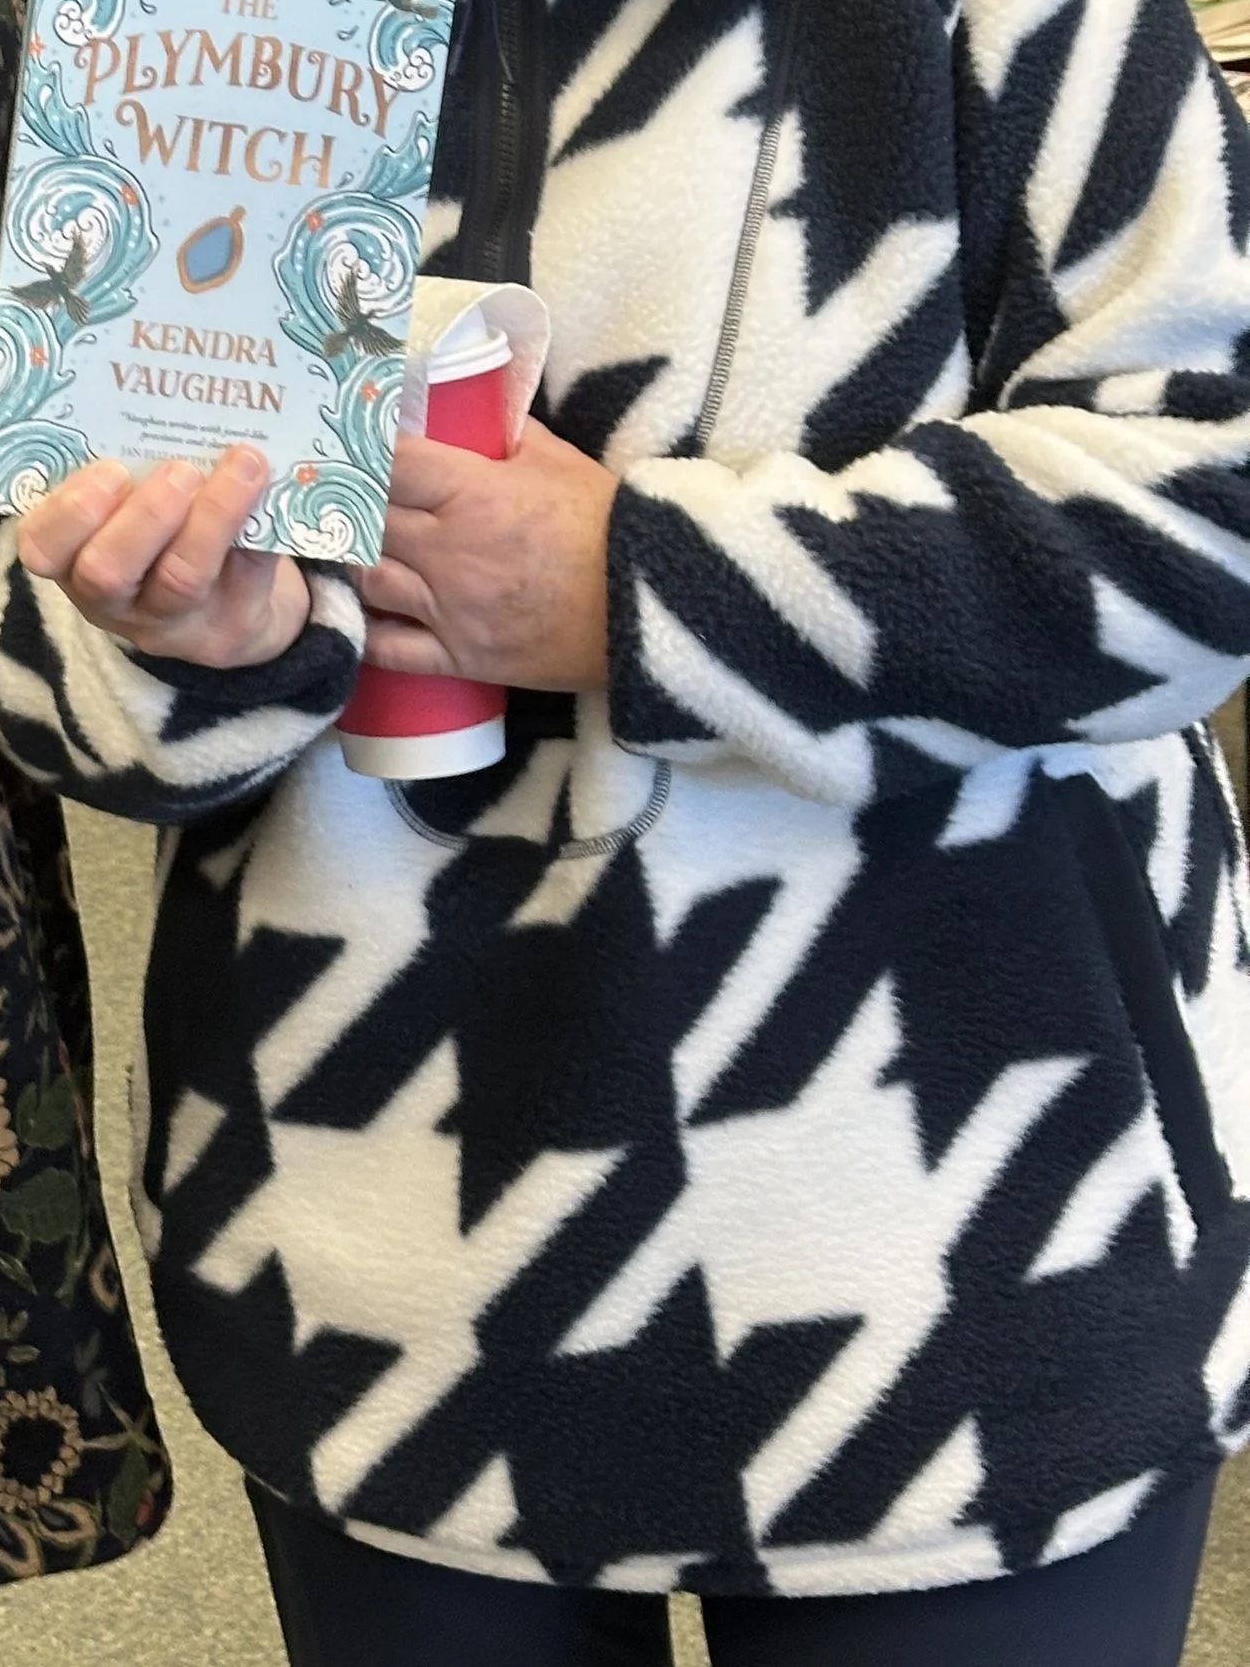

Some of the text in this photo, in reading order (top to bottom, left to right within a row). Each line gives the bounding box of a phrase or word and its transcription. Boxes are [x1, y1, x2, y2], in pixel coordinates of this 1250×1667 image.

[76, 30, 402, 137] PLYMBURY
[115, 99, 335, 188] WITCH
[130, 318, 278, 368] KENDRA
[109, 360, 285, 414] VAUGHAN
